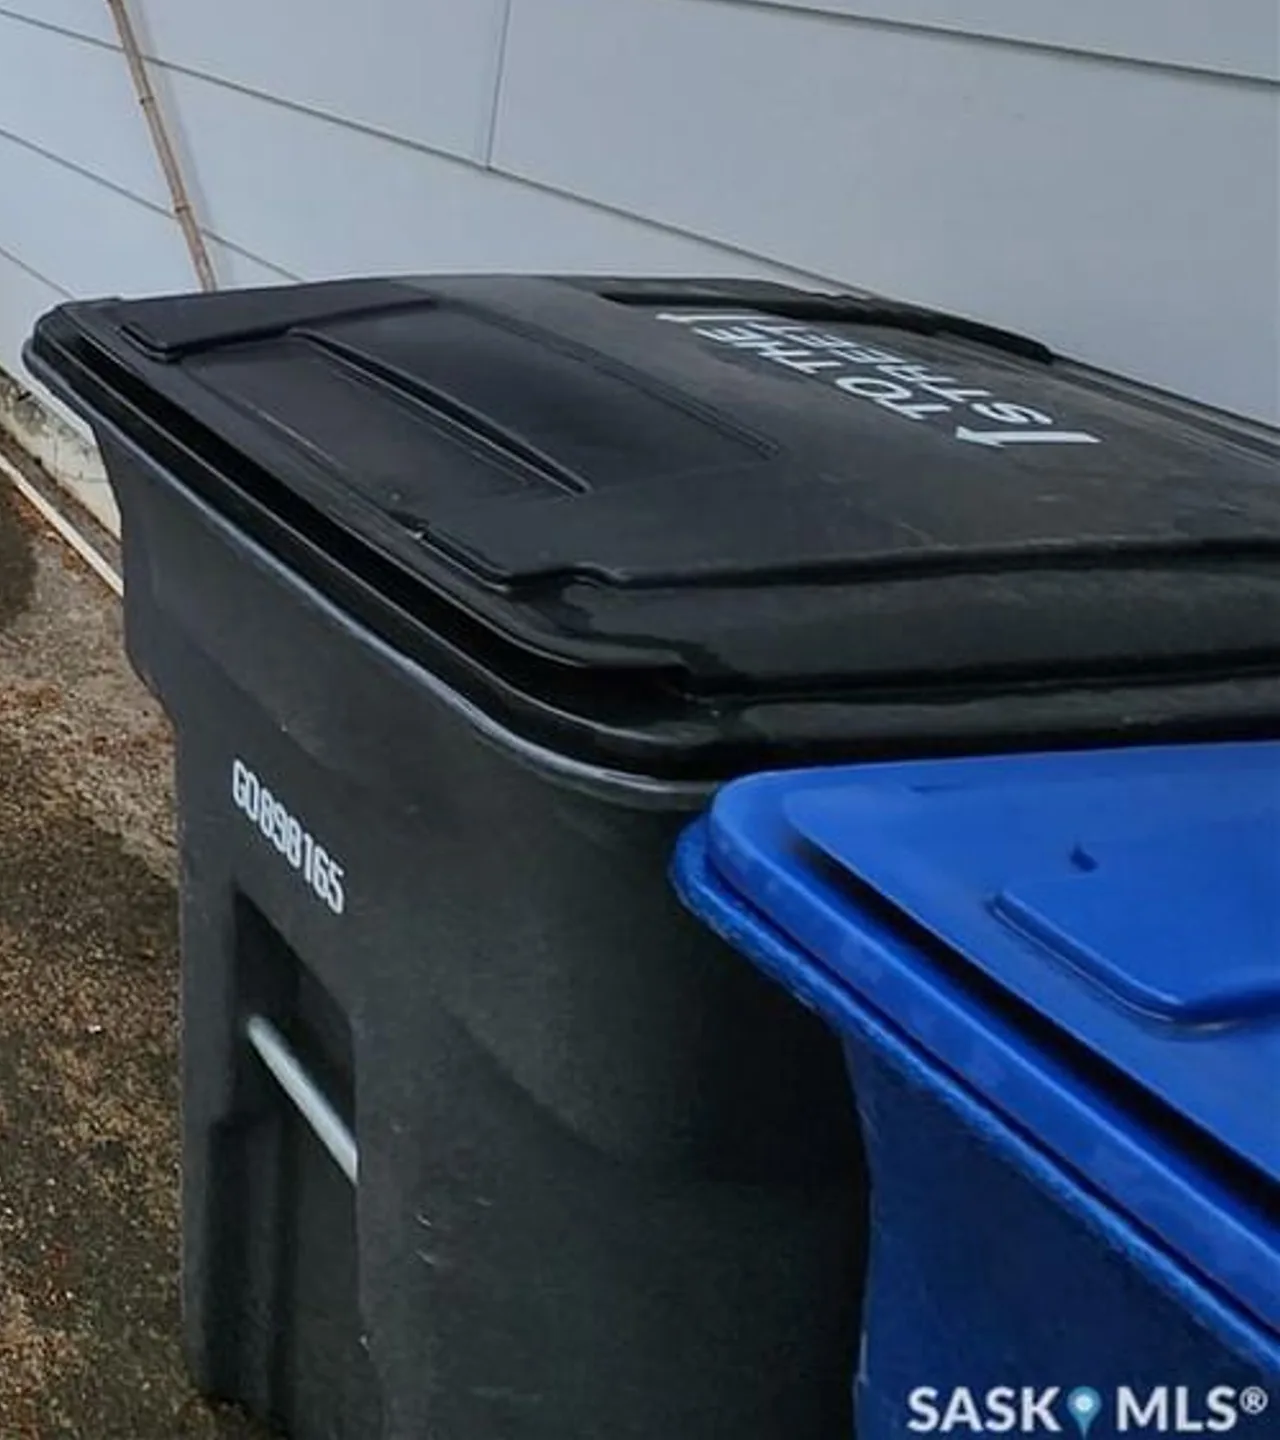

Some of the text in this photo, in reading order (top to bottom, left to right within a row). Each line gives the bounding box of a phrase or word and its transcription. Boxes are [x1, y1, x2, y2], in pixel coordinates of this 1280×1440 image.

[691, 325, 952, 420] TO THE
[745, 321, 1054, 425] STREET
